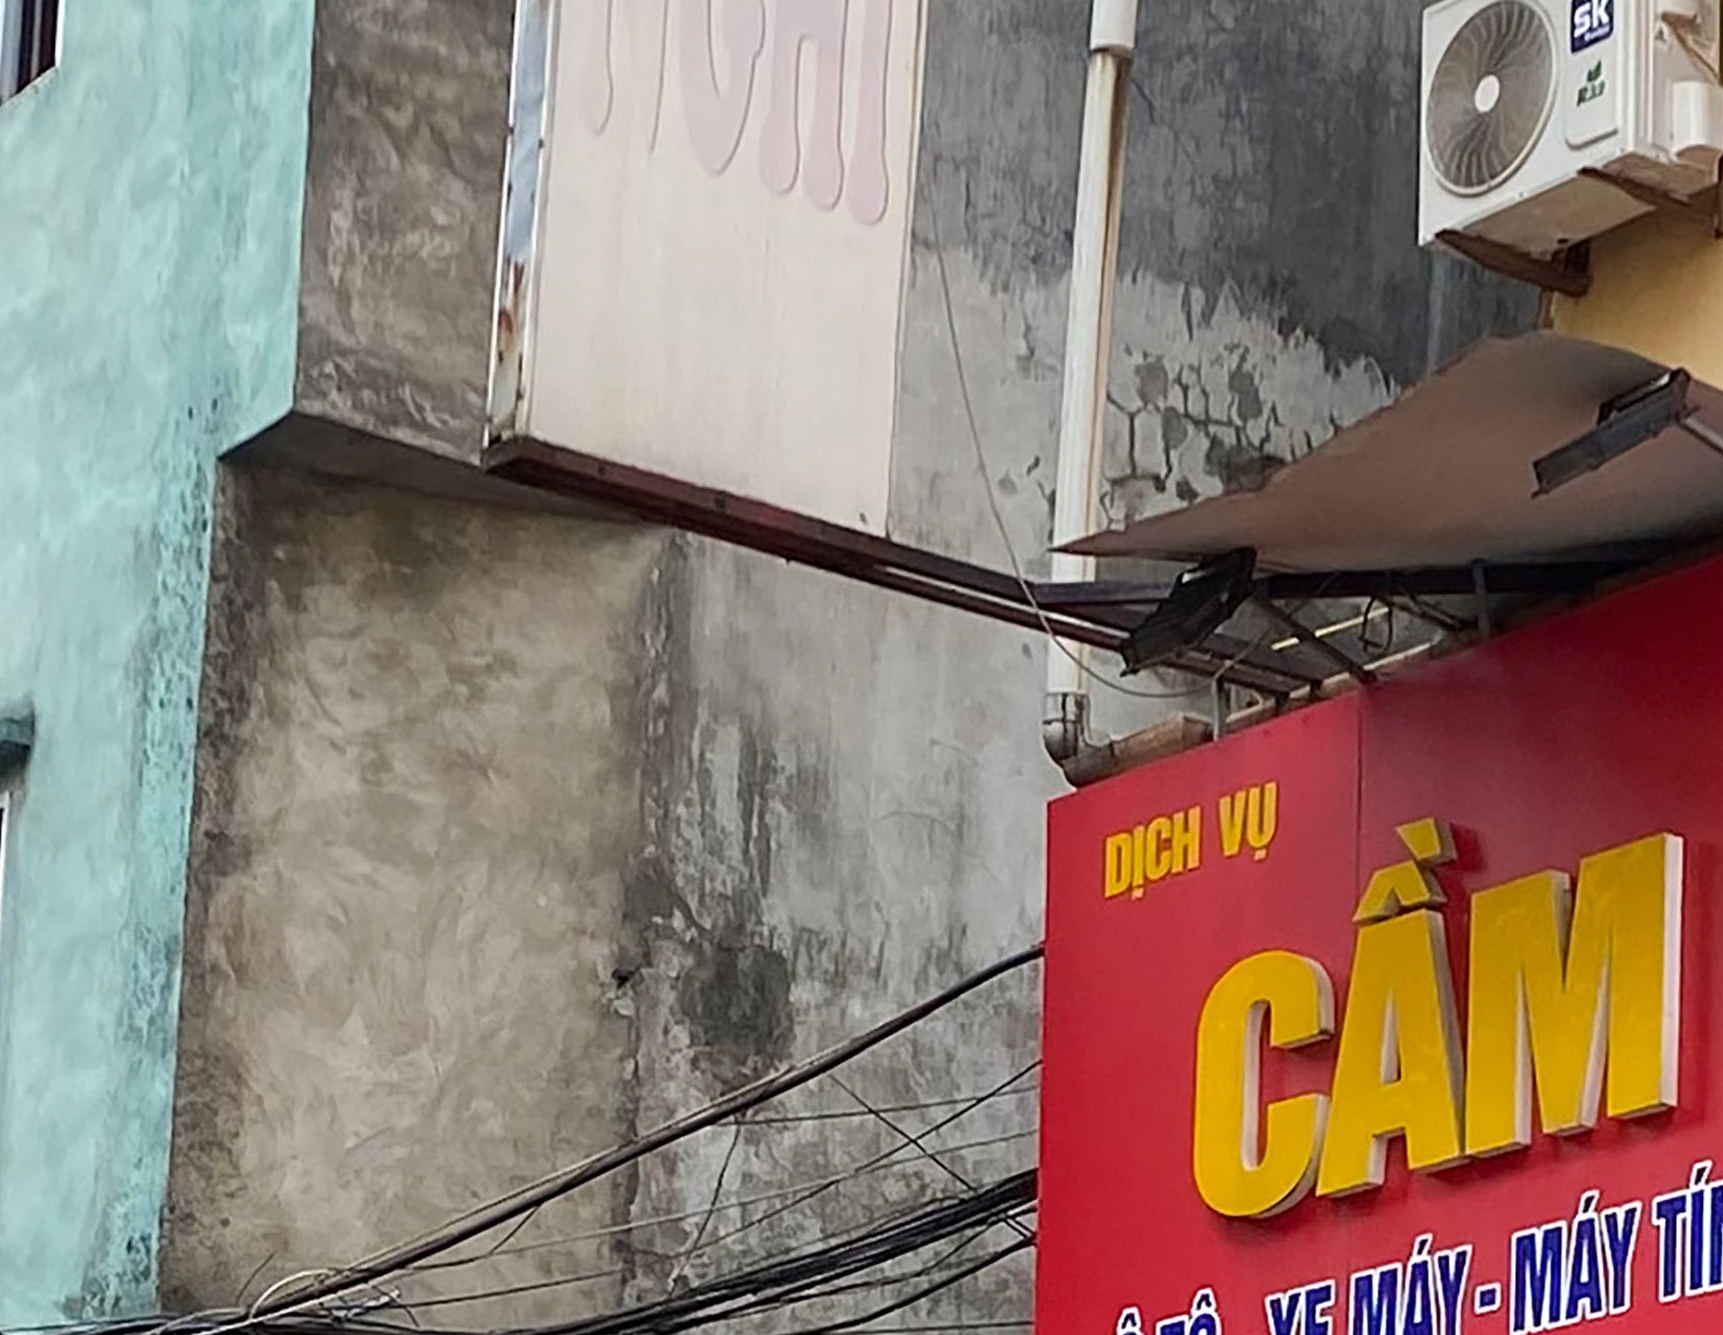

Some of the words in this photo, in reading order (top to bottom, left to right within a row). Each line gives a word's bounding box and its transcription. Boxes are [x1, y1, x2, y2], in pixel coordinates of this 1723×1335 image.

[1102, 802, 1199, 900] DỊCH
[1218, 781, 1278, 866] VỤ
[1193, 817, 1683, 1219] CẦM
